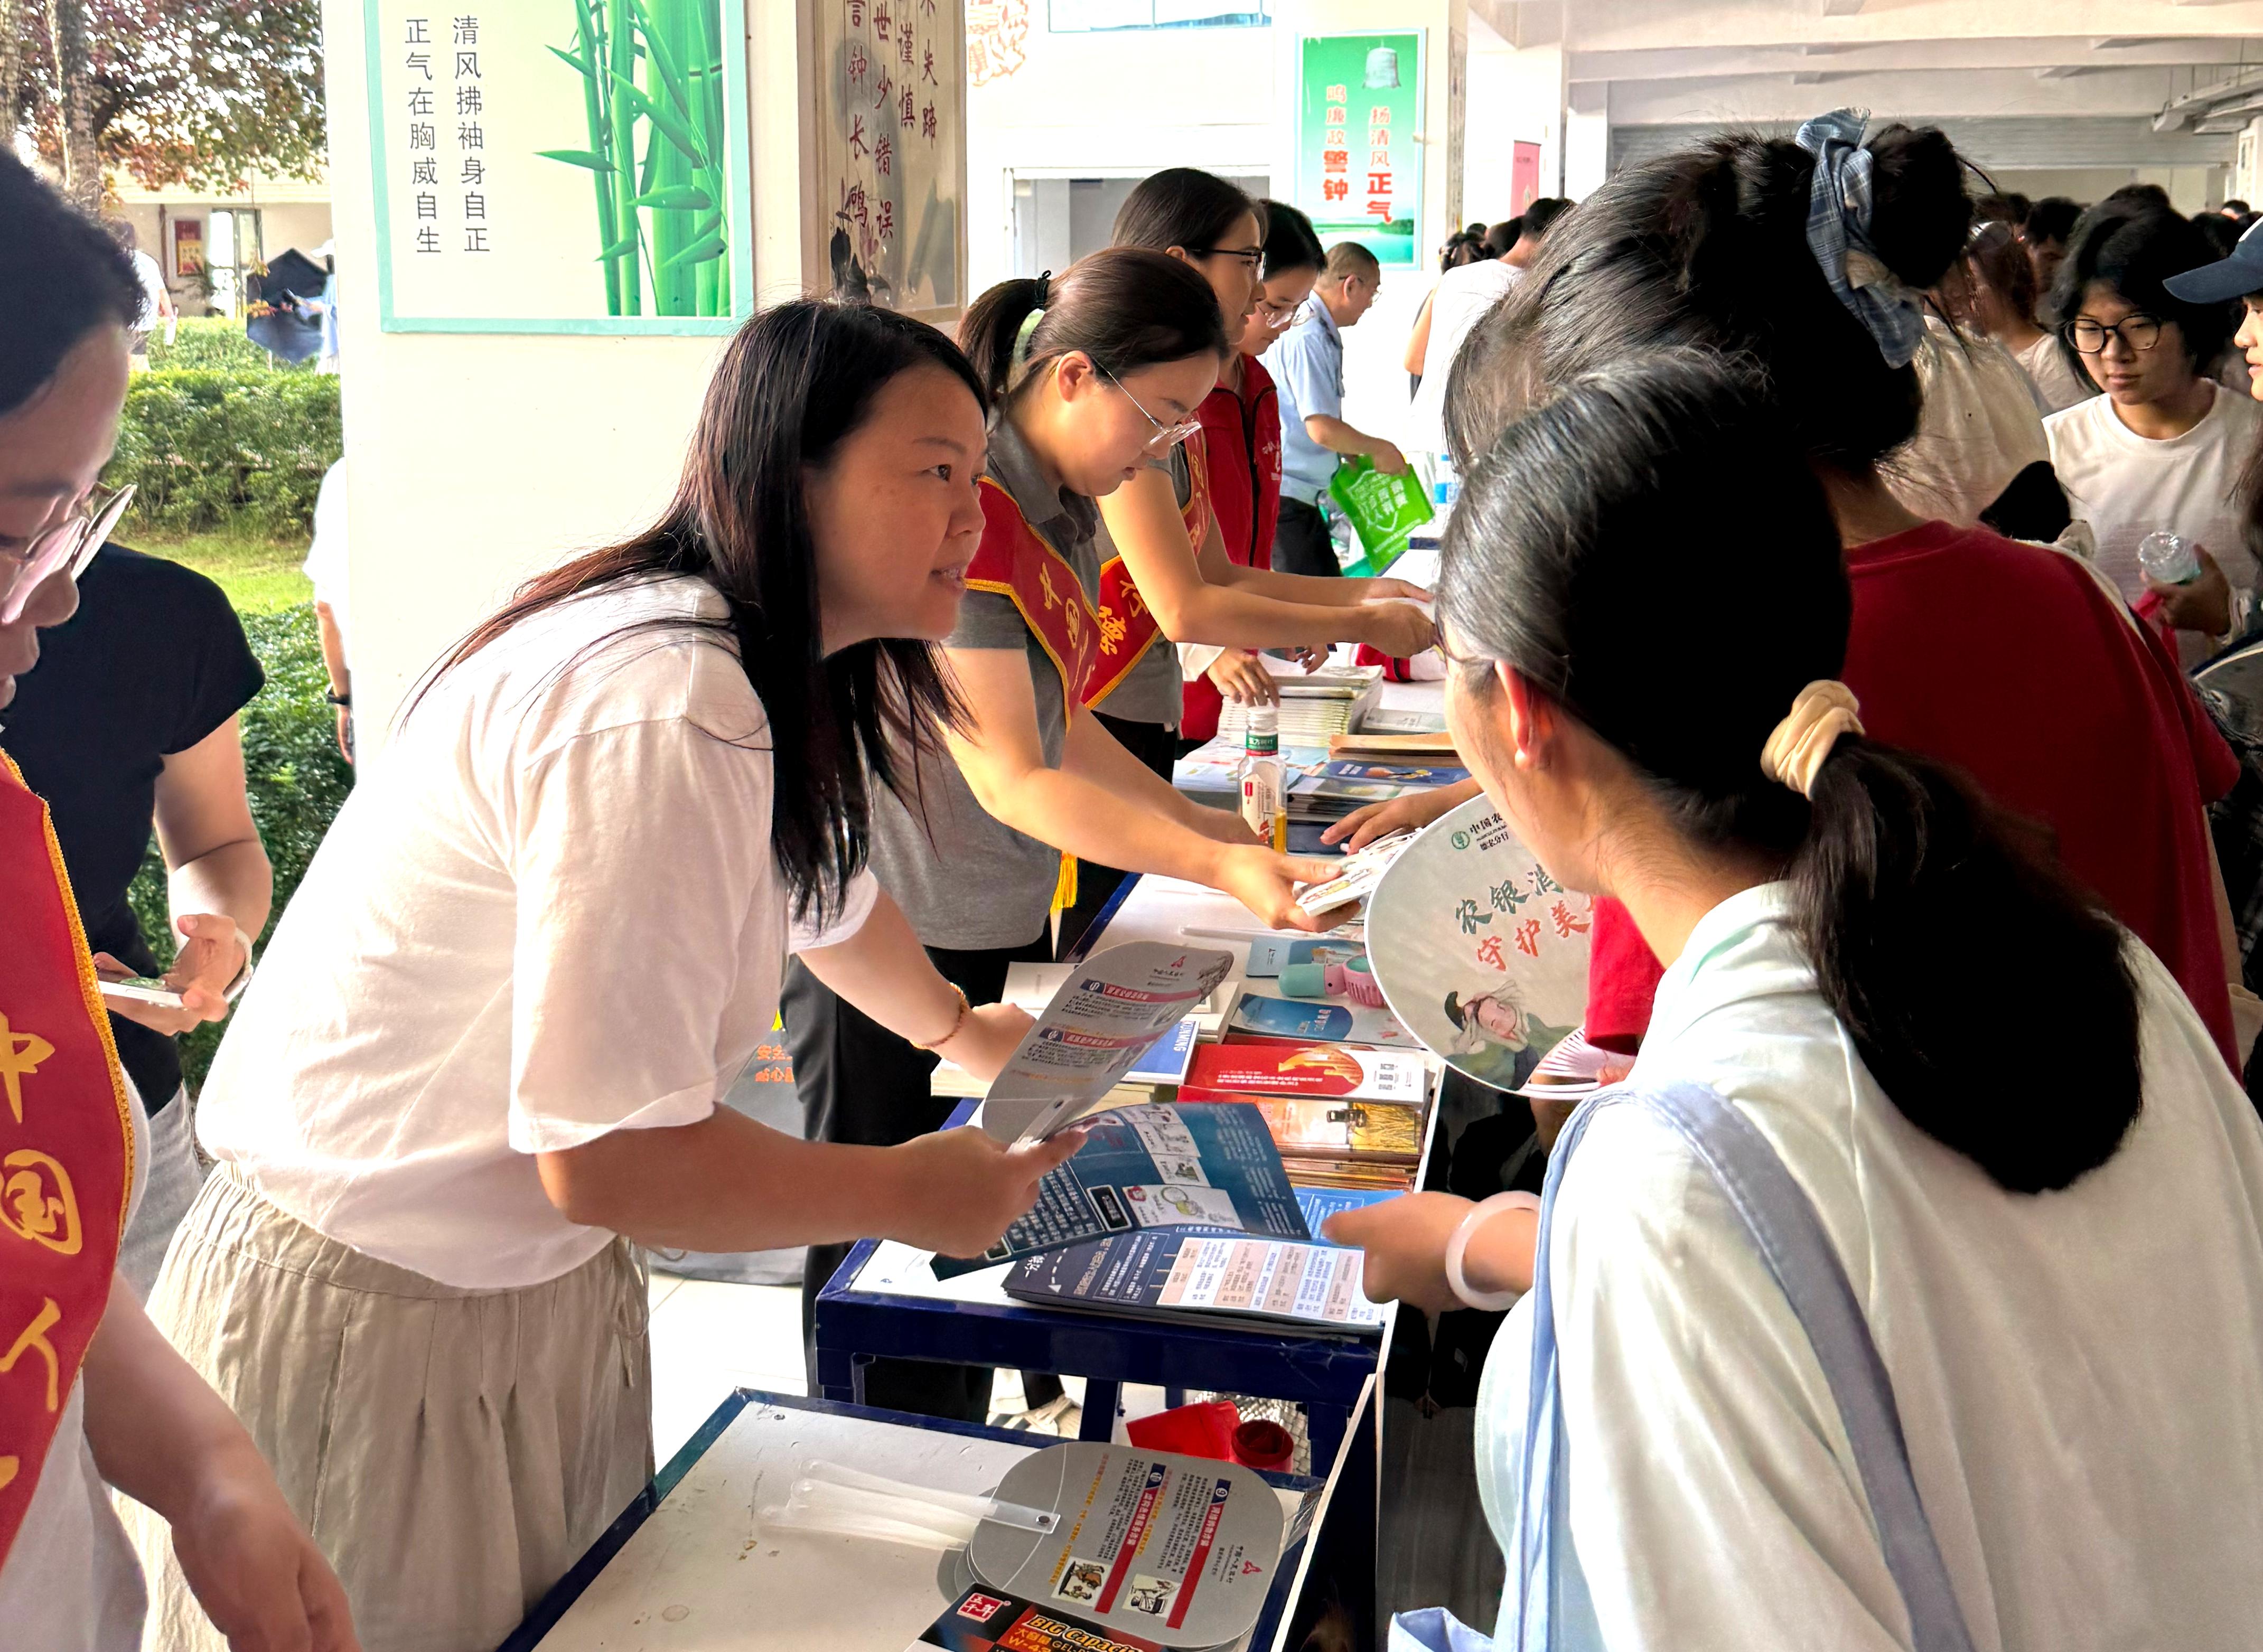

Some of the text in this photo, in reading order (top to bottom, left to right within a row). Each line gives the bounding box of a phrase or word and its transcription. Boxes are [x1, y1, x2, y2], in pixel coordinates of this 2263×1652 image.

[453, 15, 490, 252] 清风拂袖身自正
[898, 22, 915, 129] 谨慎
[405, 19, 441, 253] 正气在胸威自生
[1323, 85, 1348, 201] 鸣廉政警钟
[1367, 106, 1392, 223] 扬清风正气
[1478, 894, 1594, 971] 守护美
[0, 1011, 82, 1487] 中国人
[1026, 1616, 1139, 1652] BIG Capaci
